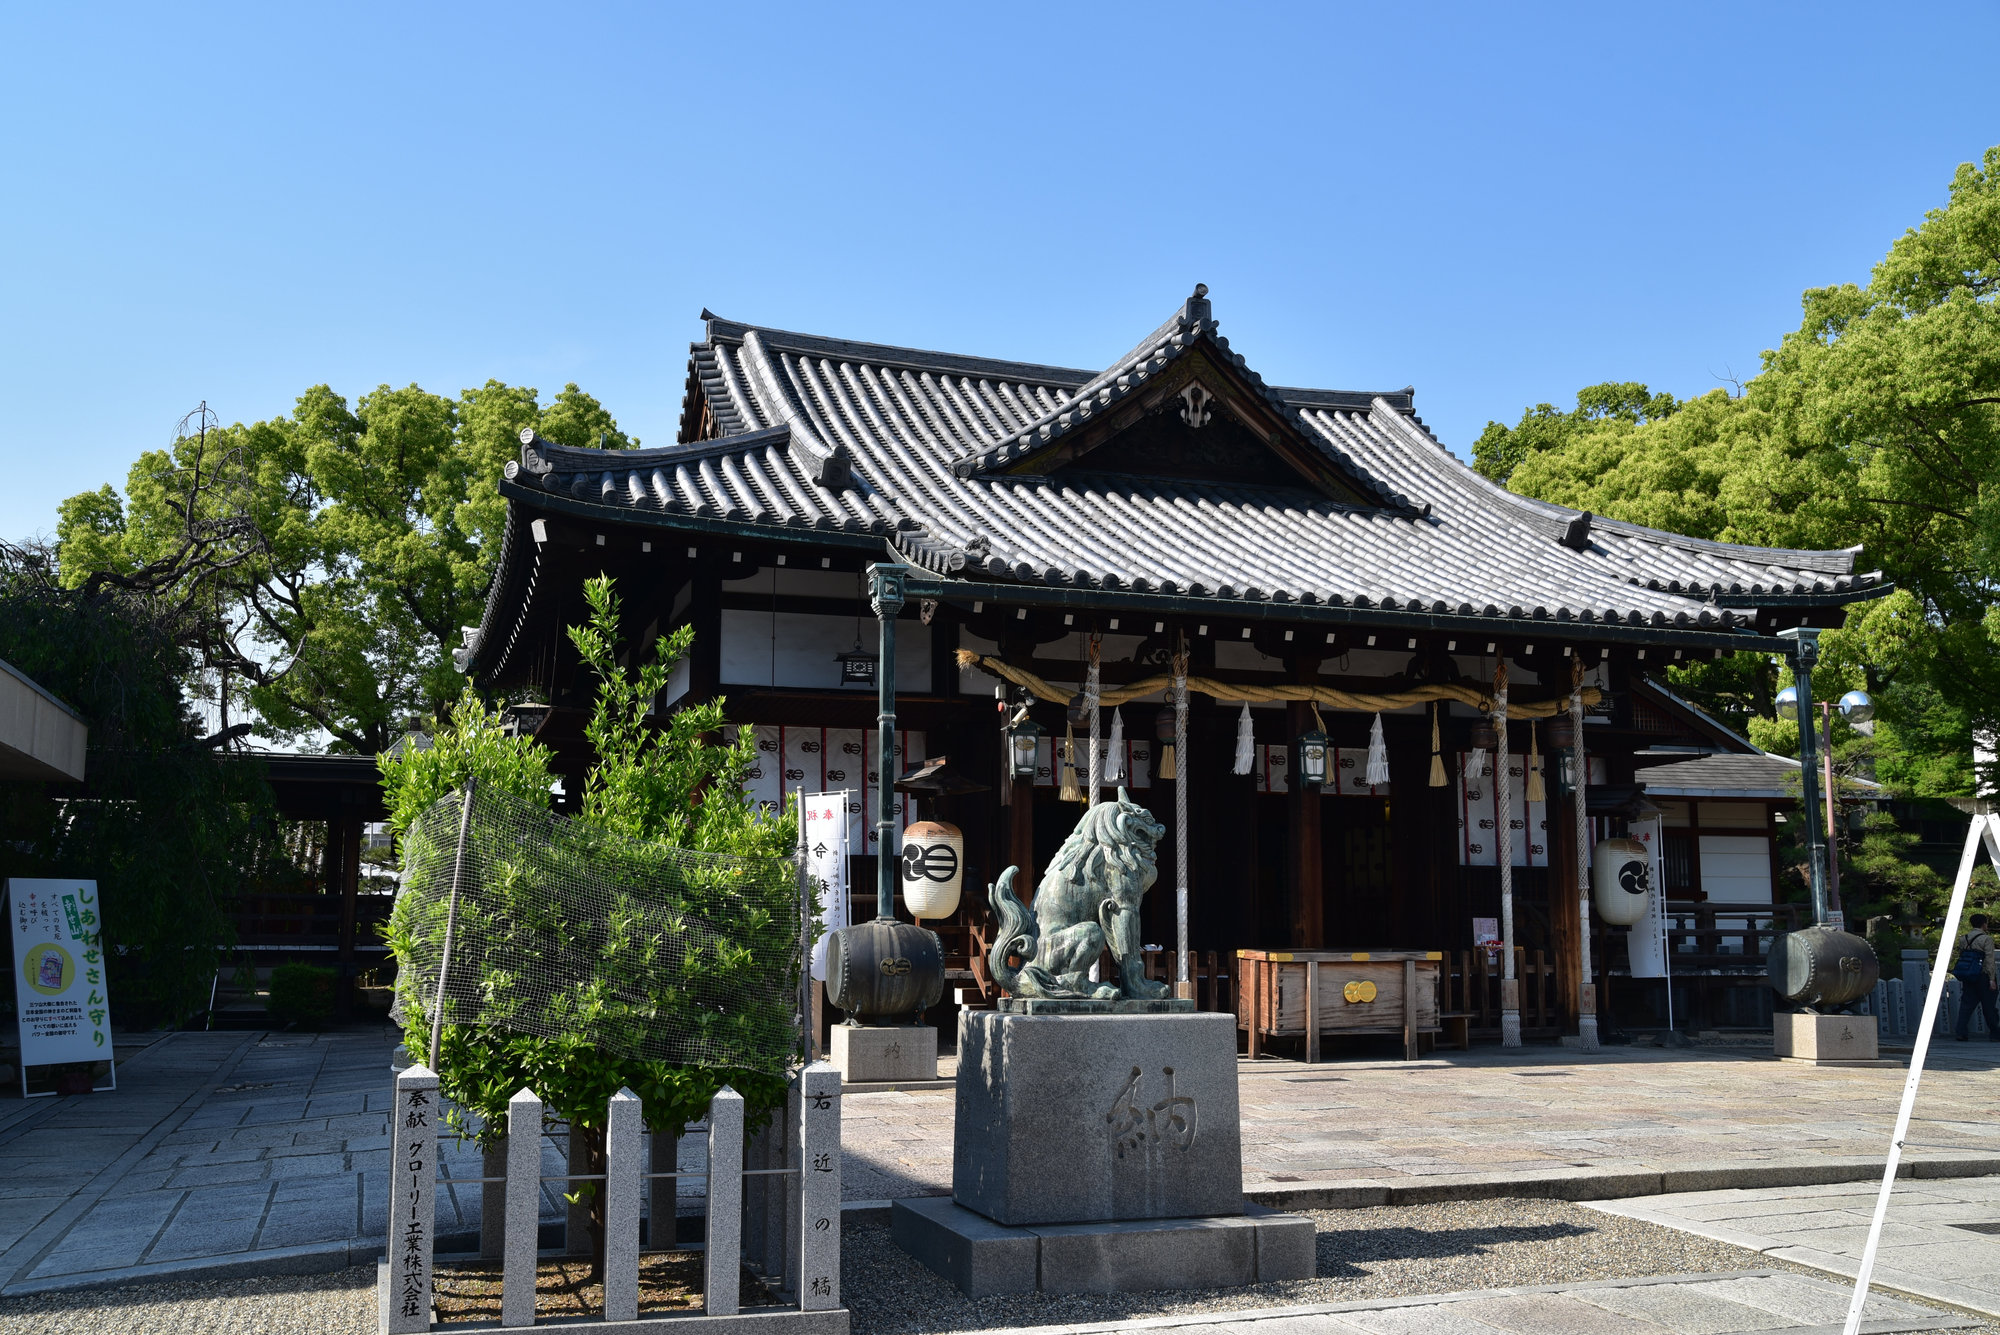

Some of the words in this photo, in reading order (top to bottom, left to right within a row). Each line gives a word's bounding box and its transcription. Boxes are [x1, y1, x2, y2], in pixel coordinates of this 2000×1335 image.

[79, 888, 106, 1048] しあわせさん守り
[405, 1090, 429, 1129] 奉献
[811, 1091, 834, 1297] 右近の橘
[401, 1139, 425, 1319] グローリー工業株式会社
